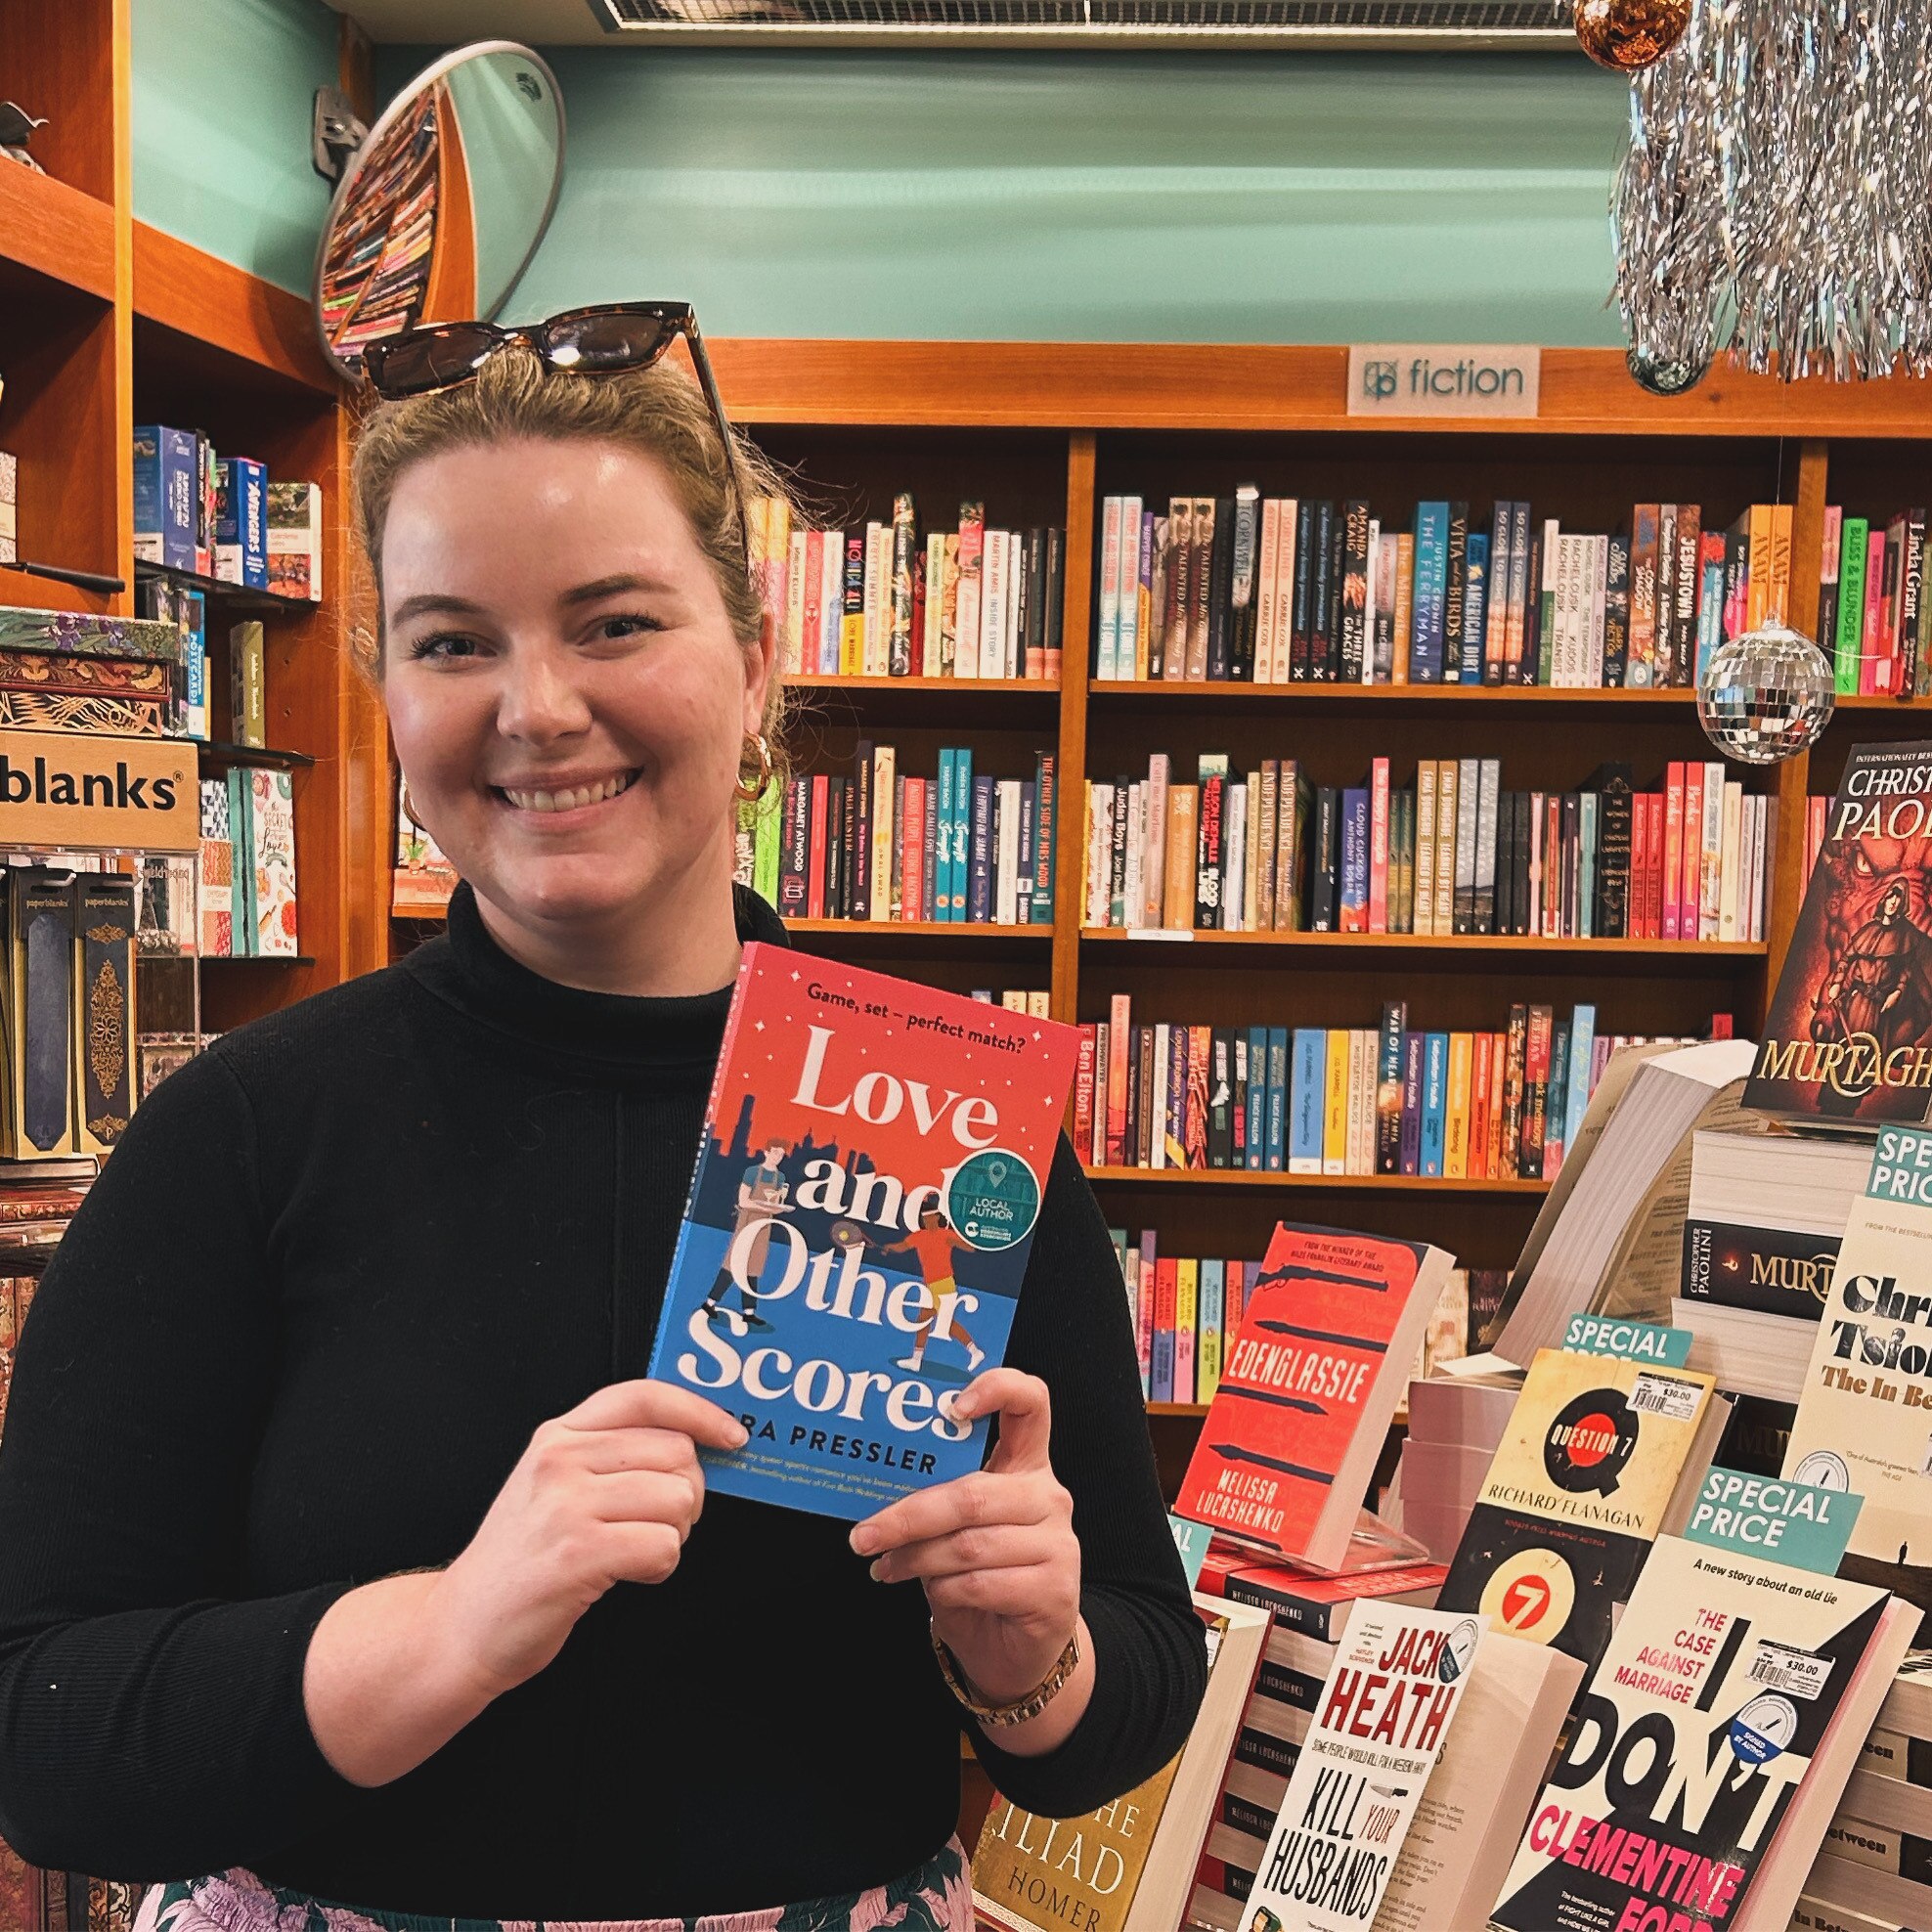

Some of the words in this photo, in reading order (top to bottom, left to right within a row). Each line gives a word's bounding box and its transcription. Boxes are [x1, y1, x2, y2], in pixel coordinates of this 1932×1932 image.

[1411, 359, 1523, 396] fiction
[247, 484, 262, 553] AVENGERS
[1346, 512, 1357, 552] CRAIG
[1356, 505, 1368, 560] AMANDA
[1421, 515, 1434, 549] THE
[990, 535, 1001, 569] MARTIN
[1449, 518, 1465, 560] VITA
[1559, 538, 1568, 578] RACHEL
[1570, 538, 1580, 578] RACHEL
[1848, 526, 1862, 561] BLISS
[1907, 522, 1924, 570] Linda
[1433, 541, 1442, 582] JUSTIN
[1677, 539, 1695, 619] JESUSTOWN
[1847, 565, 1860, 576] &
[989, 571, 999, 594] AMIS
[1556, 583, 1566, 613] CUSK
[1569, 583, 1578, 613] CUSK
[1904, 571, 1922, 619] Grant
[988, 598, 998, 627] INSIDE
[1417, 559, 1434, 657] FERRYMAN
[1430, 587, 1440, 634] CRONIN
[1446, 588, 1462, 637] BIRDS
[1465, 584, 1483, 643] AMERICAN
[1842, 579, 1860, 643] BLUNDER
[988, 630, 997, 658] STORY
[1342, 616, 1353, 661] GRACES
[1553, 627, 1564, 675] TRANSIT
[1566, 636, 1577, 675] KUDOS
[1463, 645, 1479, 674] DIRT
[1041, 757, 1053, 774] THE
[796, 781, 807, 829] MARGARET
[1041, 775, 1053, 805] OTHER
[1115, 787, 1127, 820] Judas
[1209, 775, 1221, 818] NELSON
[1039, 827, 1050, 840] OF
[1040, 807, 1051, 825] SIDE
[1356, 803, 1365, 837] CLOUD
[794, 830, 805, 871] ATWOOD
[1038, 841, 1050, 860] MRS
[1113, 822, 1126, 851] Boys
[1036, 861, 1049, 888] WOOD
[1355, 839, 1365, 881] CUCKOO
[1354, 883, 1364, 910] LAND
[806, 982, 860, 1015] Game,
[863, 1001, 889, 1018] set
[905, 1011, 965, 1039] perfect
[968, 1029, 1027, 1055] match?
[1389, 1008, 1400, 1033] WAR
[1080, 1040, 1094, 1071] Ben
[1388, 1036, 1399, 1052] OF
[1409, 1038, 1419, 1080] Sebastian
[1430, 1039, 1440, 1081] Sebastian
[790, 1025, 998, 1149] Love
[1077, 1073, 1092, 1113] Elton
[1407, 1081, 1417, 1110] Faulks
[1428, 1082, 1439, 1110] Faulks
[1451, 1118, 1461, 1154] Birdsong
[796, 1158, 960, 1235] and
[969, 1206, 1014, 1222] AUTHOR
[976, 1198, 1010, 1212] LOCAL
[730, 1217, 979, 1340] Other
[1698, 1229, 1712, 1295] PAOLINI
[1564, 1318, 1667, 1359] SPECIAL
[678, 1305, 974, 1442] Scores
[1228, 1338, 1370, 1405] EDENGLASSIE
[1822, 1365, 1866, 1396] The
[725, 1408, 776, 1441] RA
[790, 1426, 938, 1476] PRESSLER
[1551, 1424, 1619, 1455] QUESTION
[1619, 1436, 1633, 1458] 7
[1216, 1468, 1279, 1503] MELISSA
[1702, 1471, 1831, 1525] SPECIAL
[1196, 1491, 1286, 1534] LUCASHENKO
[1487, 1483, 1557, 1511] RICHARD
[1560, 1499, 1646, 1530] FLANAGAN
[1690, 1503, 1787, 1548] PRICE
[1232, 1590, 1259, 1606] MELISSA
[1693, 1558, 1702, 1570] A
[1703, 1562, 1726, 1577] new
[1727, 1566, 1755, 1587] story
[1756, 1573, 1787, 1594] about
[1788, 1585, 1804, 1597] an
[1804, 1587, 1822, 1601] old
[1822, 1590, 1838, 1605] lie
[1515, 1583, 1545, 1631] 7
[1697, 1608, 1729, 1633] THE
[1379, 1627, 1451, 1679] JACK
[1637, 1641, 1705, 1680] AGAINST
[1674, 1630, 1717, 1656] CASE
[1613, 1665, 1694, 1704] MARRIAGE
[1786, 1659, 1819, 1676] $30.00
[1319, 1666, 1457, 1752] HEATH
[1093, 1797, 1141, 1839] HE
[1300, 1767, 1368, 1841] KILL
[1358, 1804, 1400, 1845] YOUR
[1827, 1826, 1887, 1855] etween
[995, 1804, 1125, 1896] ILIAD
[1529, 1805, 1746, 1919] CLEMENTINE
[1262, 1828, 1388, 1920] HUSBANDS
[1008, 1866, 1103, 1932] HOMER
[1613, 1896, 1714, 1932] FO
